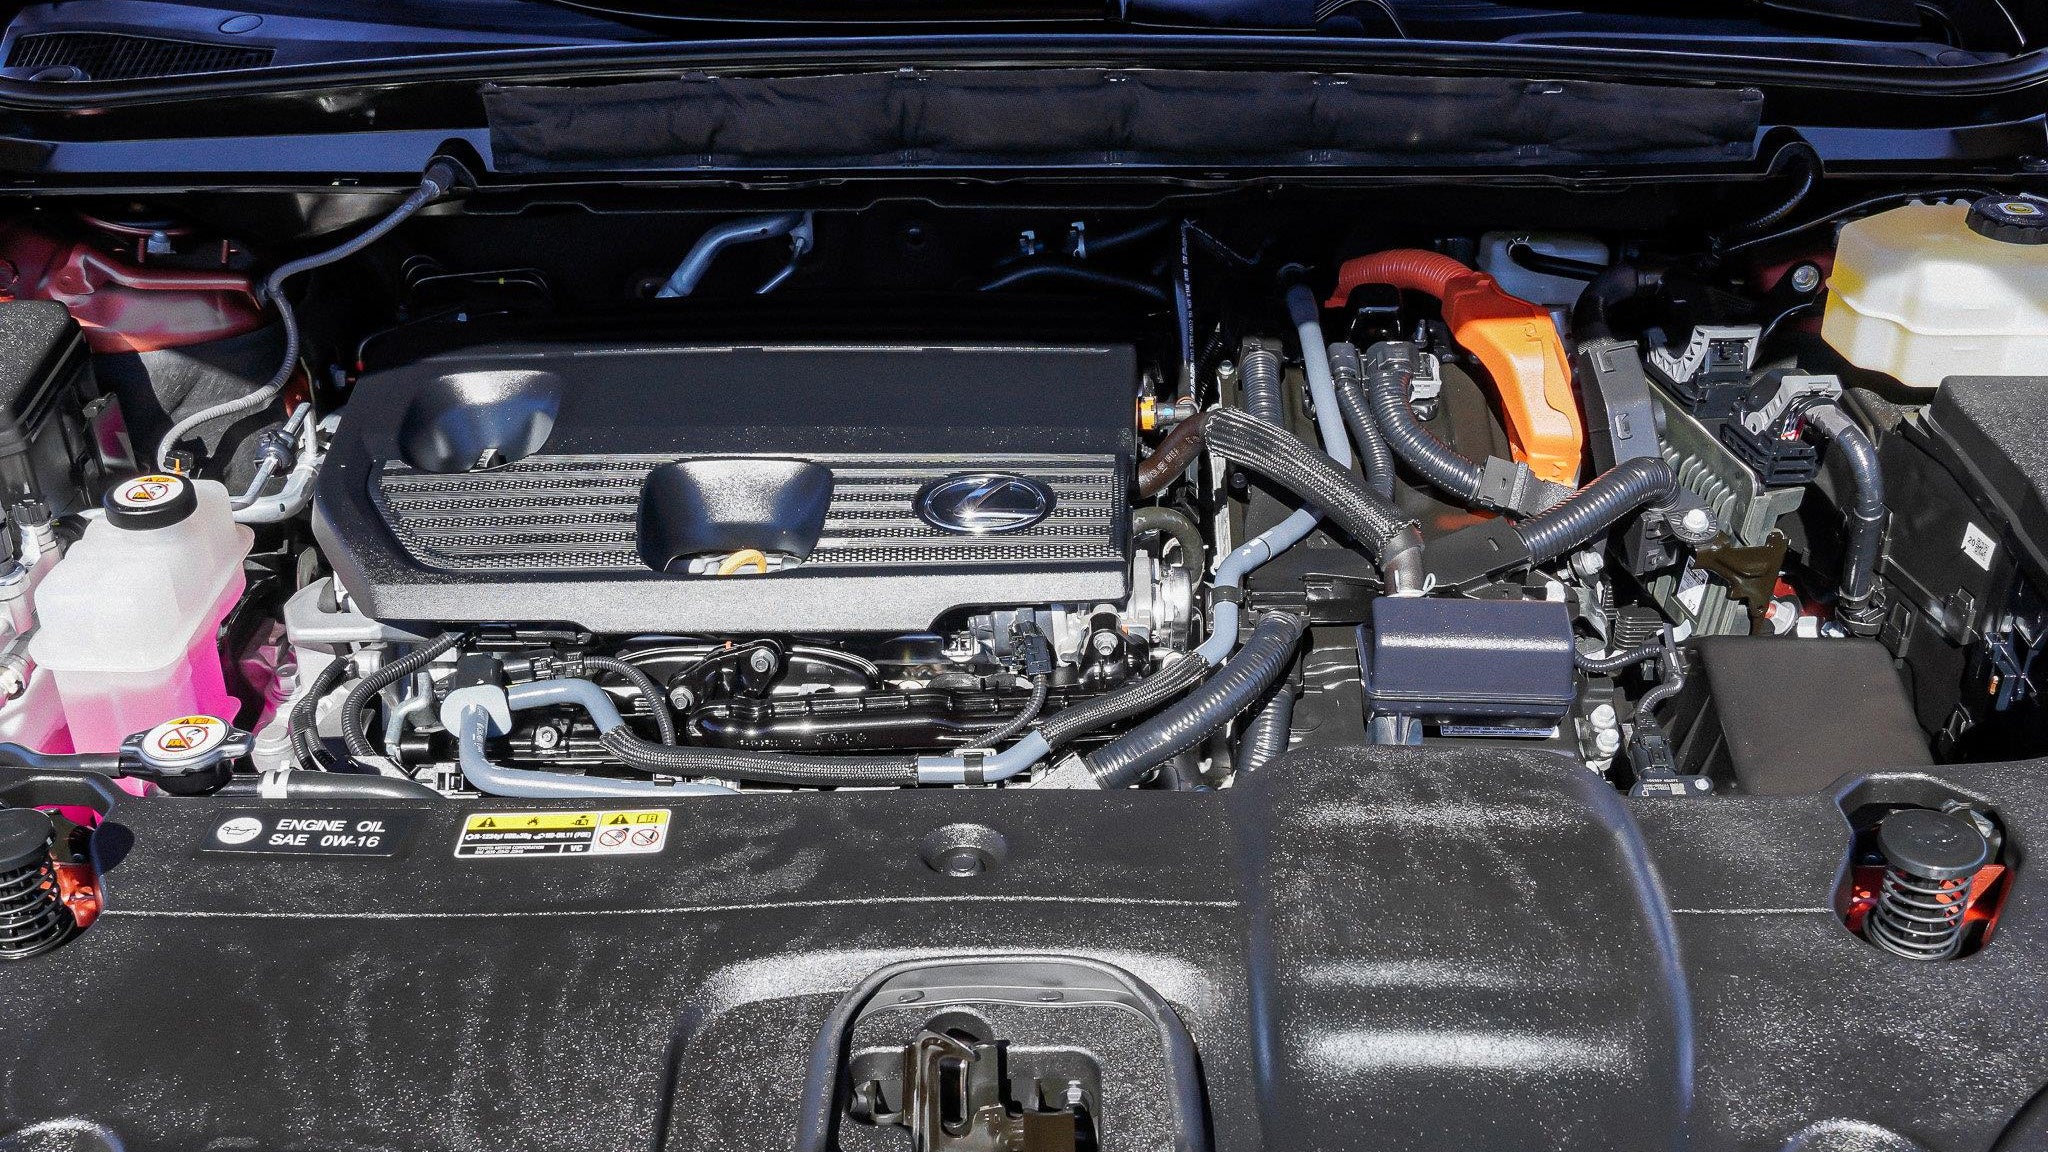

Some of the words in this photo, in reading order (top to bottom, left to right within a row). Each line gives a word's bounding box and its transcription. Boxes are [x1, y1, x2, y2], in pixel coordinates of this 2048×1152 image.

[276, 818, 347, 832] ENGINE
[356, 820, 386, 833] OIL
[268, 833, 310, 846] SAE
[320, 835, 381, 848] 0W-16
[570, 844, 584, 852] VC
